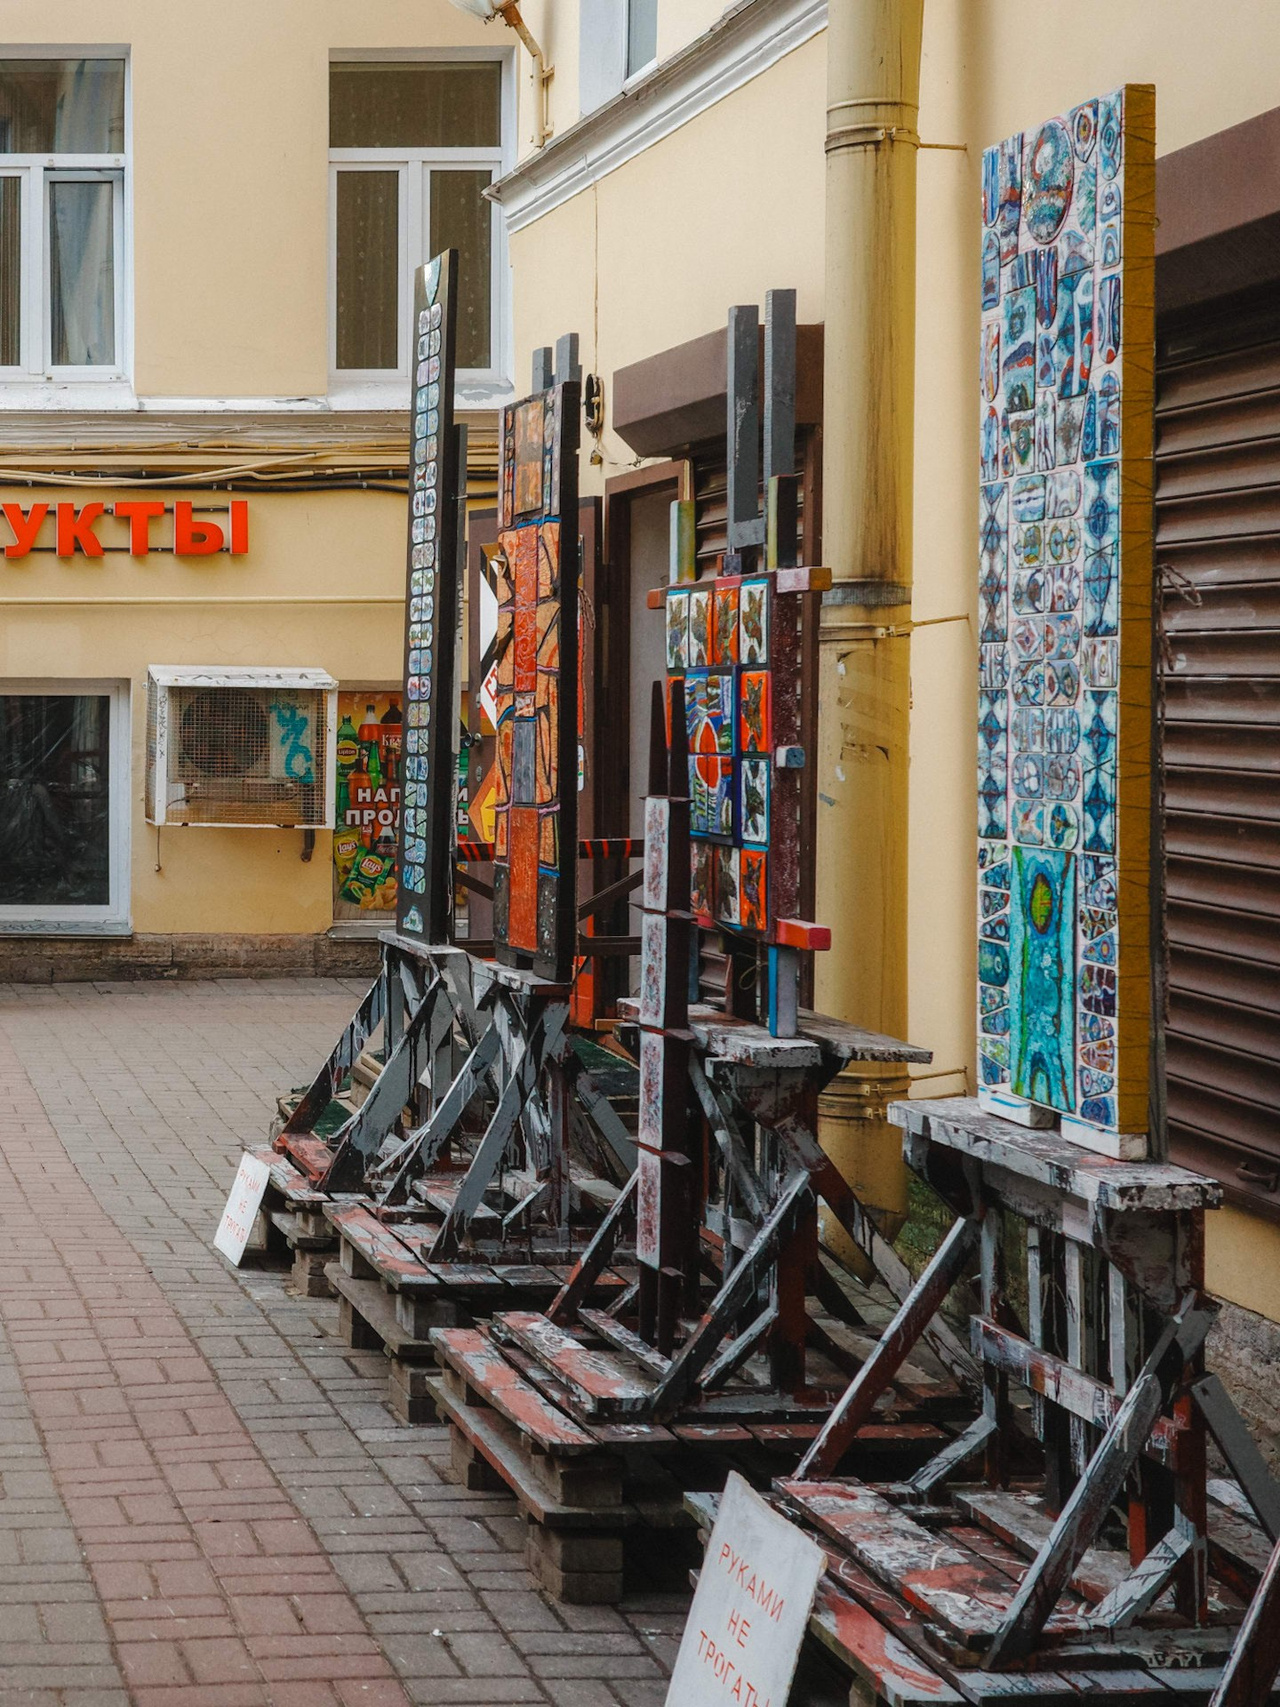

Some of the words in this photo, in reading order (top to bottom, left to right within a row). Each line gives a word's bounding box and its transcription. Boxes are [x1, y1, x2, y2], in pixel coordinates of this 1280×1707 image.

[357, 787, 468, 802] НАПИ
[718, 1543, 785, 1623] РУКАМИ
[727, 1608, 751, 1648] НЕ
